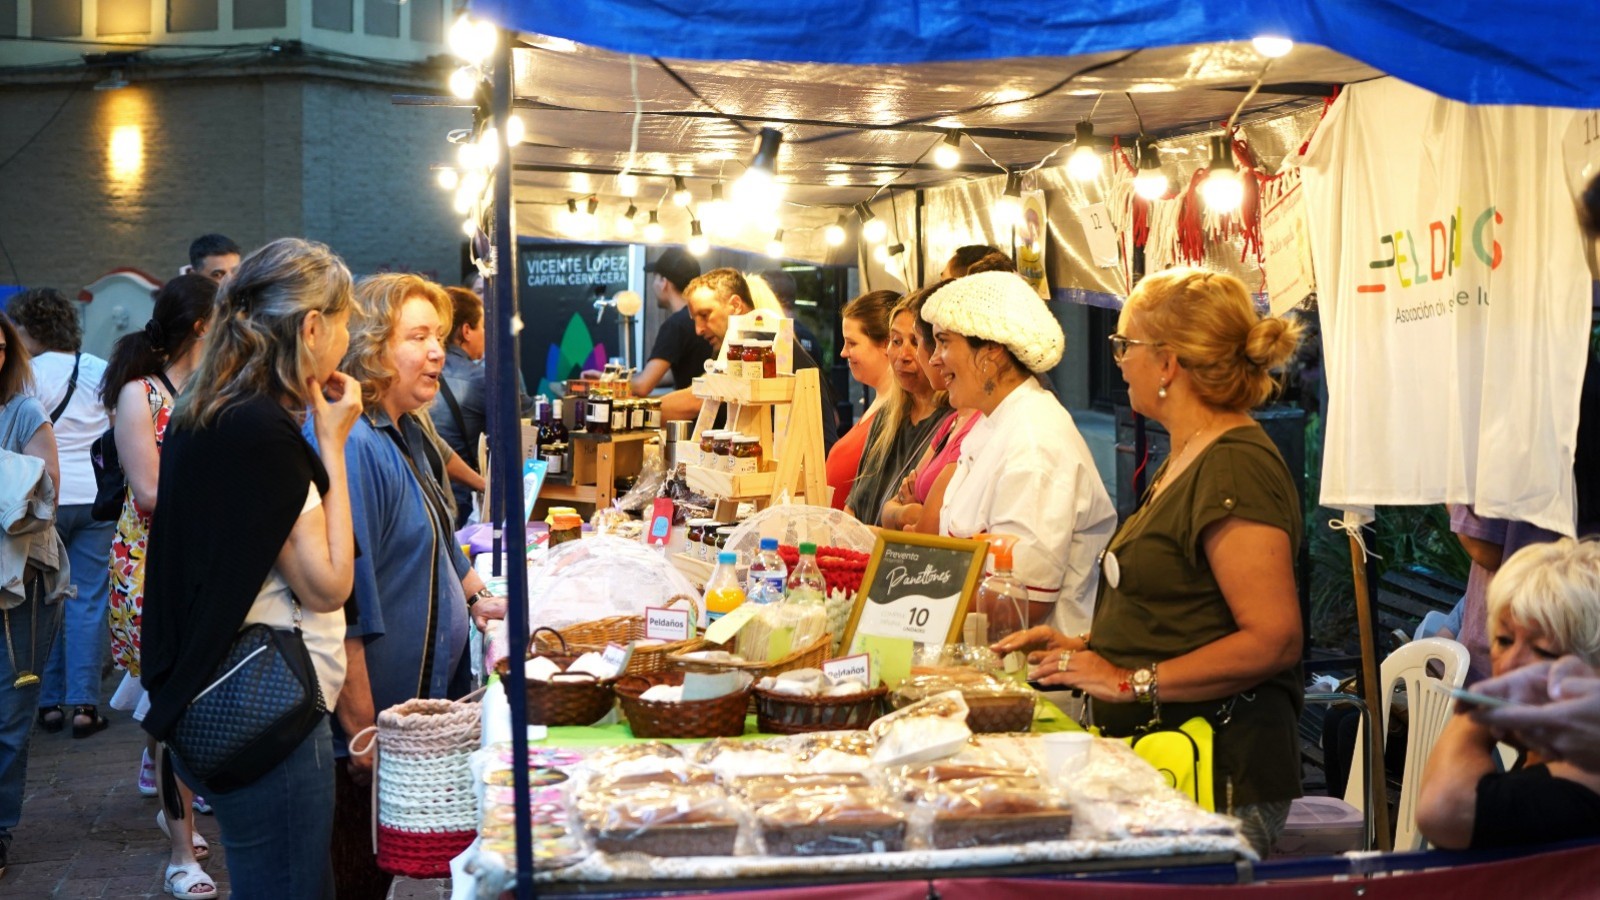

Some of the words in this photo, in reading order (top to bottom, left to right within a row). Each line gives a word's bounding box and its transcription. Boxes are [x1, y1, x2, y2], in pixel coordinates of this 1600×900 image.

[527, 257, 582, 274] VICENTE
[528, 274, 566, 286] CAPITAL
[568, 272, 627, 285] CERVECERA
[885, 549, 919, 561] Preventa
[649, 617, 684, 629] Peldaños
[909, 607, 930, 627] 10
